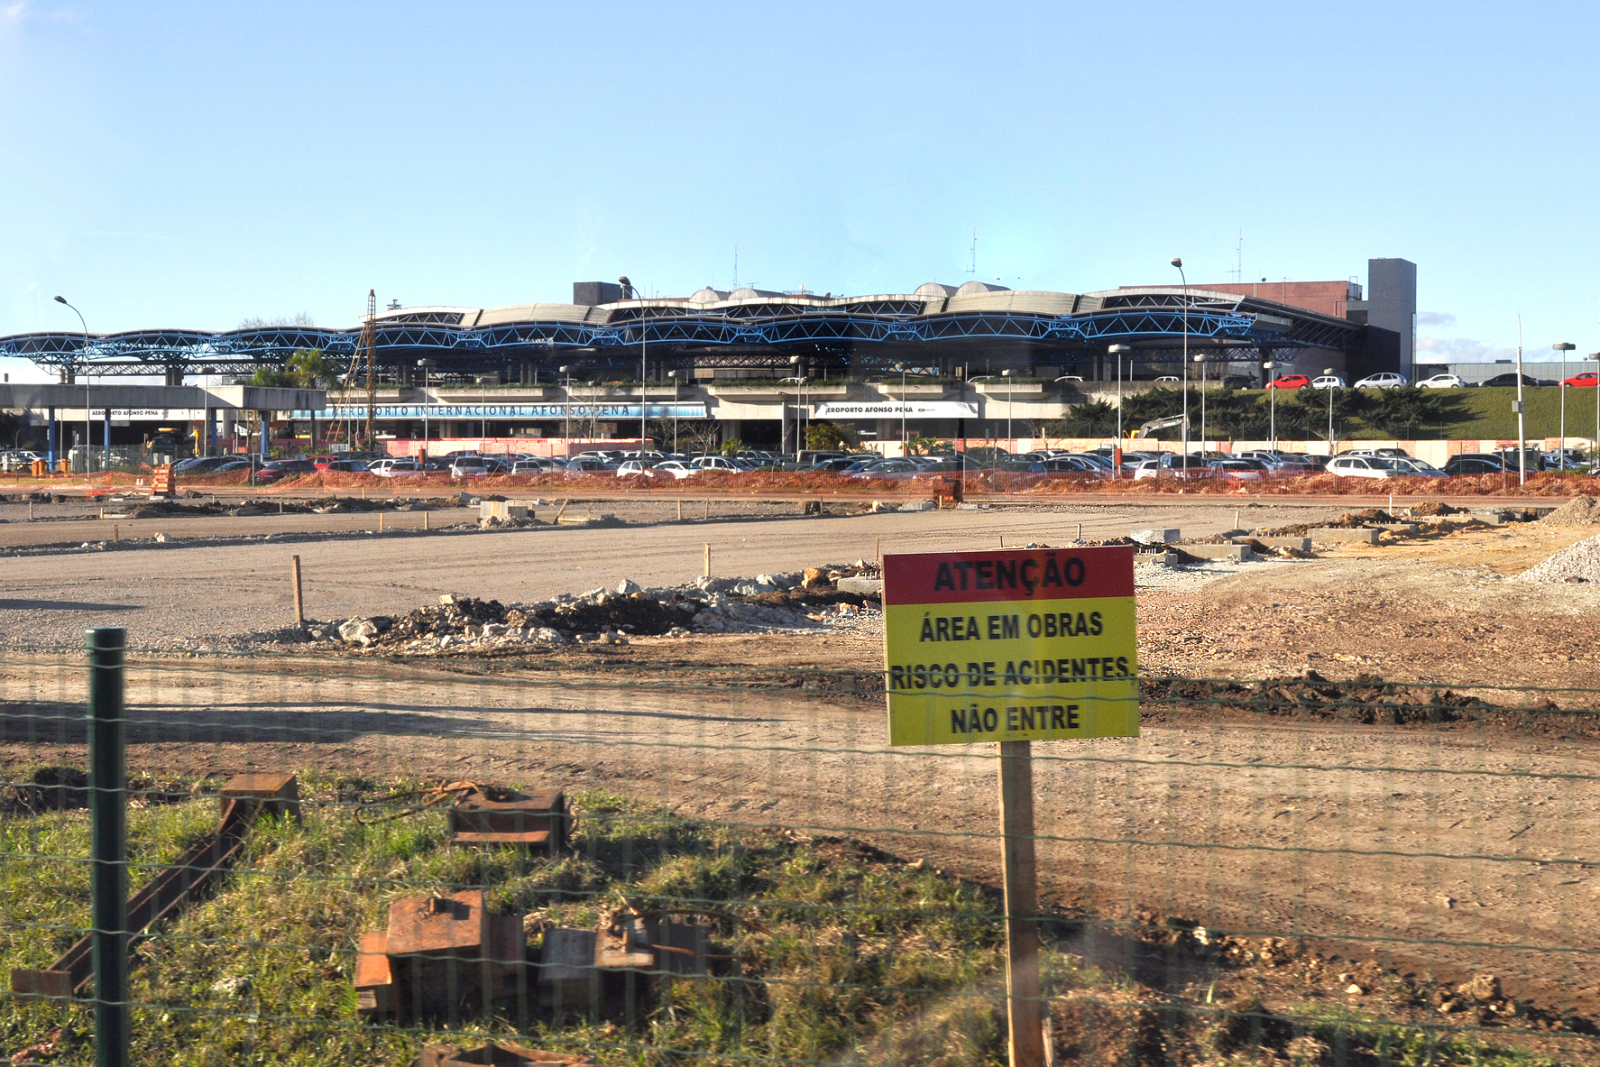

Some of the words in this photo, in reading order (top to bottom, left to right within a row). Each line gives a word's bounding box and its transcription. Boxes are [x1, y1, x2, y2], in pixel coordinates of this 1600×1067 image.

[332, 405, 409, 416] AEROORTO
[415, 405, 525, 416] INTERNACIONAL
[531, 405, 586, 416] AFONSO
[594, 405, 630, 415] PENA
[934, 552, 1087, 596] ATENÇÃO
[919, 611, 981, 643] ÁREA
[987, 613, 1020, 640] EM
[1027, 611, 1103, 639] OBRAS
[890, 663, 960, 690] RISCO
[966, 661, 996, 687] DE
[951, 703, 998, 735] NÃO
[1006, 704, 1080, 732] ENTRE
